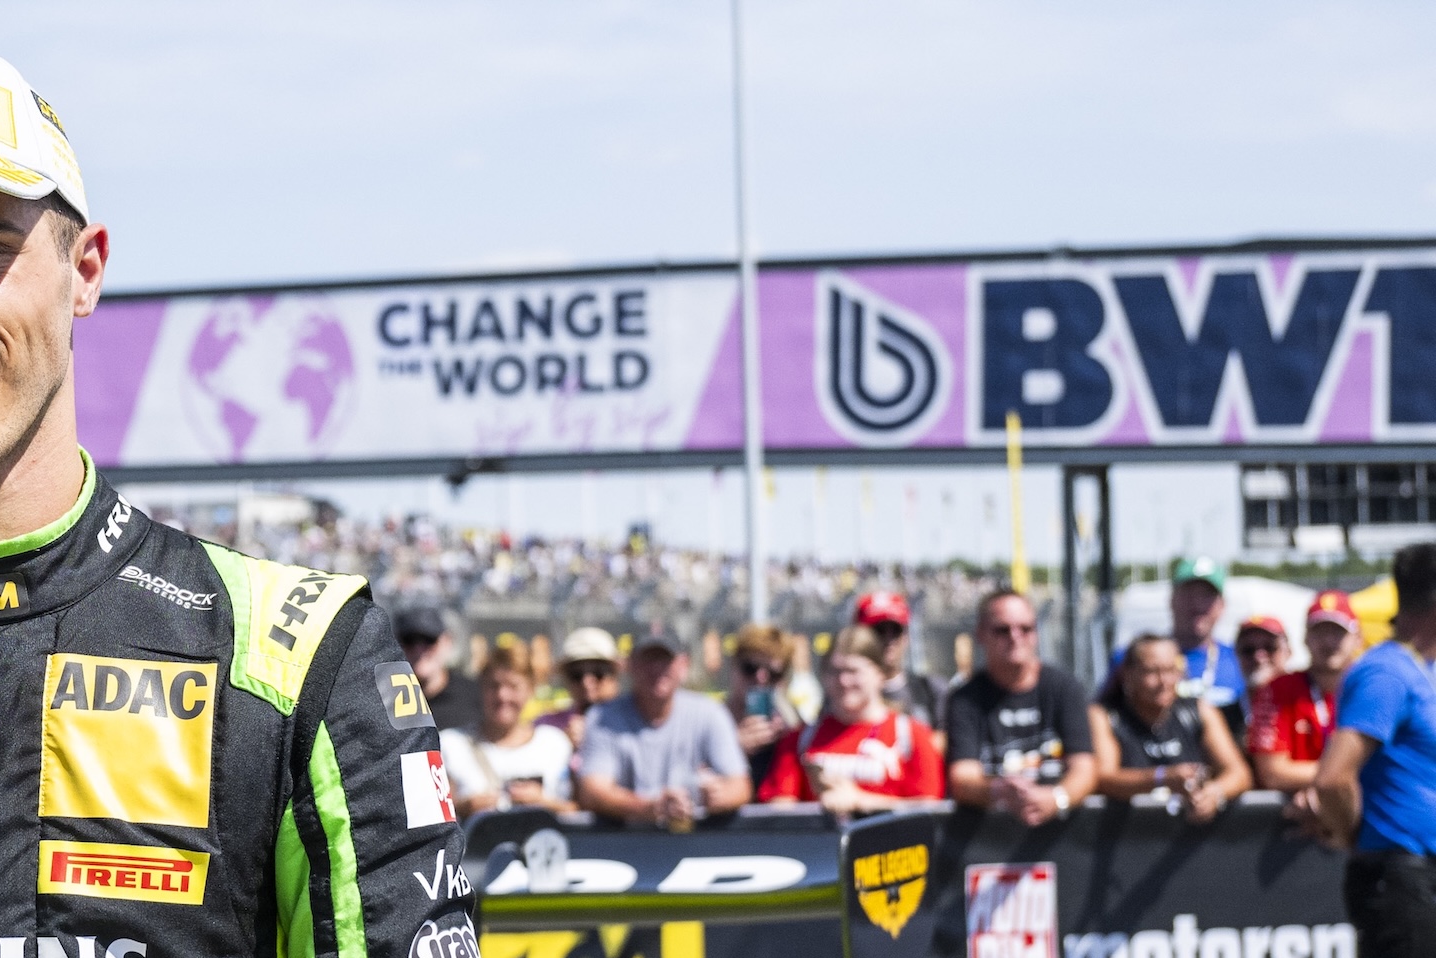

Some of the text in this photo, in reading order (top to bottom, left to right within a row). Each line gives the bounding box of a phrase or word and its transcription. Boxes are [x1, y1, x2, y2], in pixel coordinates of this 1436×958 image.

[377, 289, 646, 348] CHANGE
[982, 265, 1436, 429] BWT
[432, 350, 650, 397] WORLD
[118, 565, 219, 606] PADDOCK
[137, 580, 194, 610] LEGENDS
[50, 660, 208, 721] ADAC
[50, 851, 194, 893] PIRELLI
